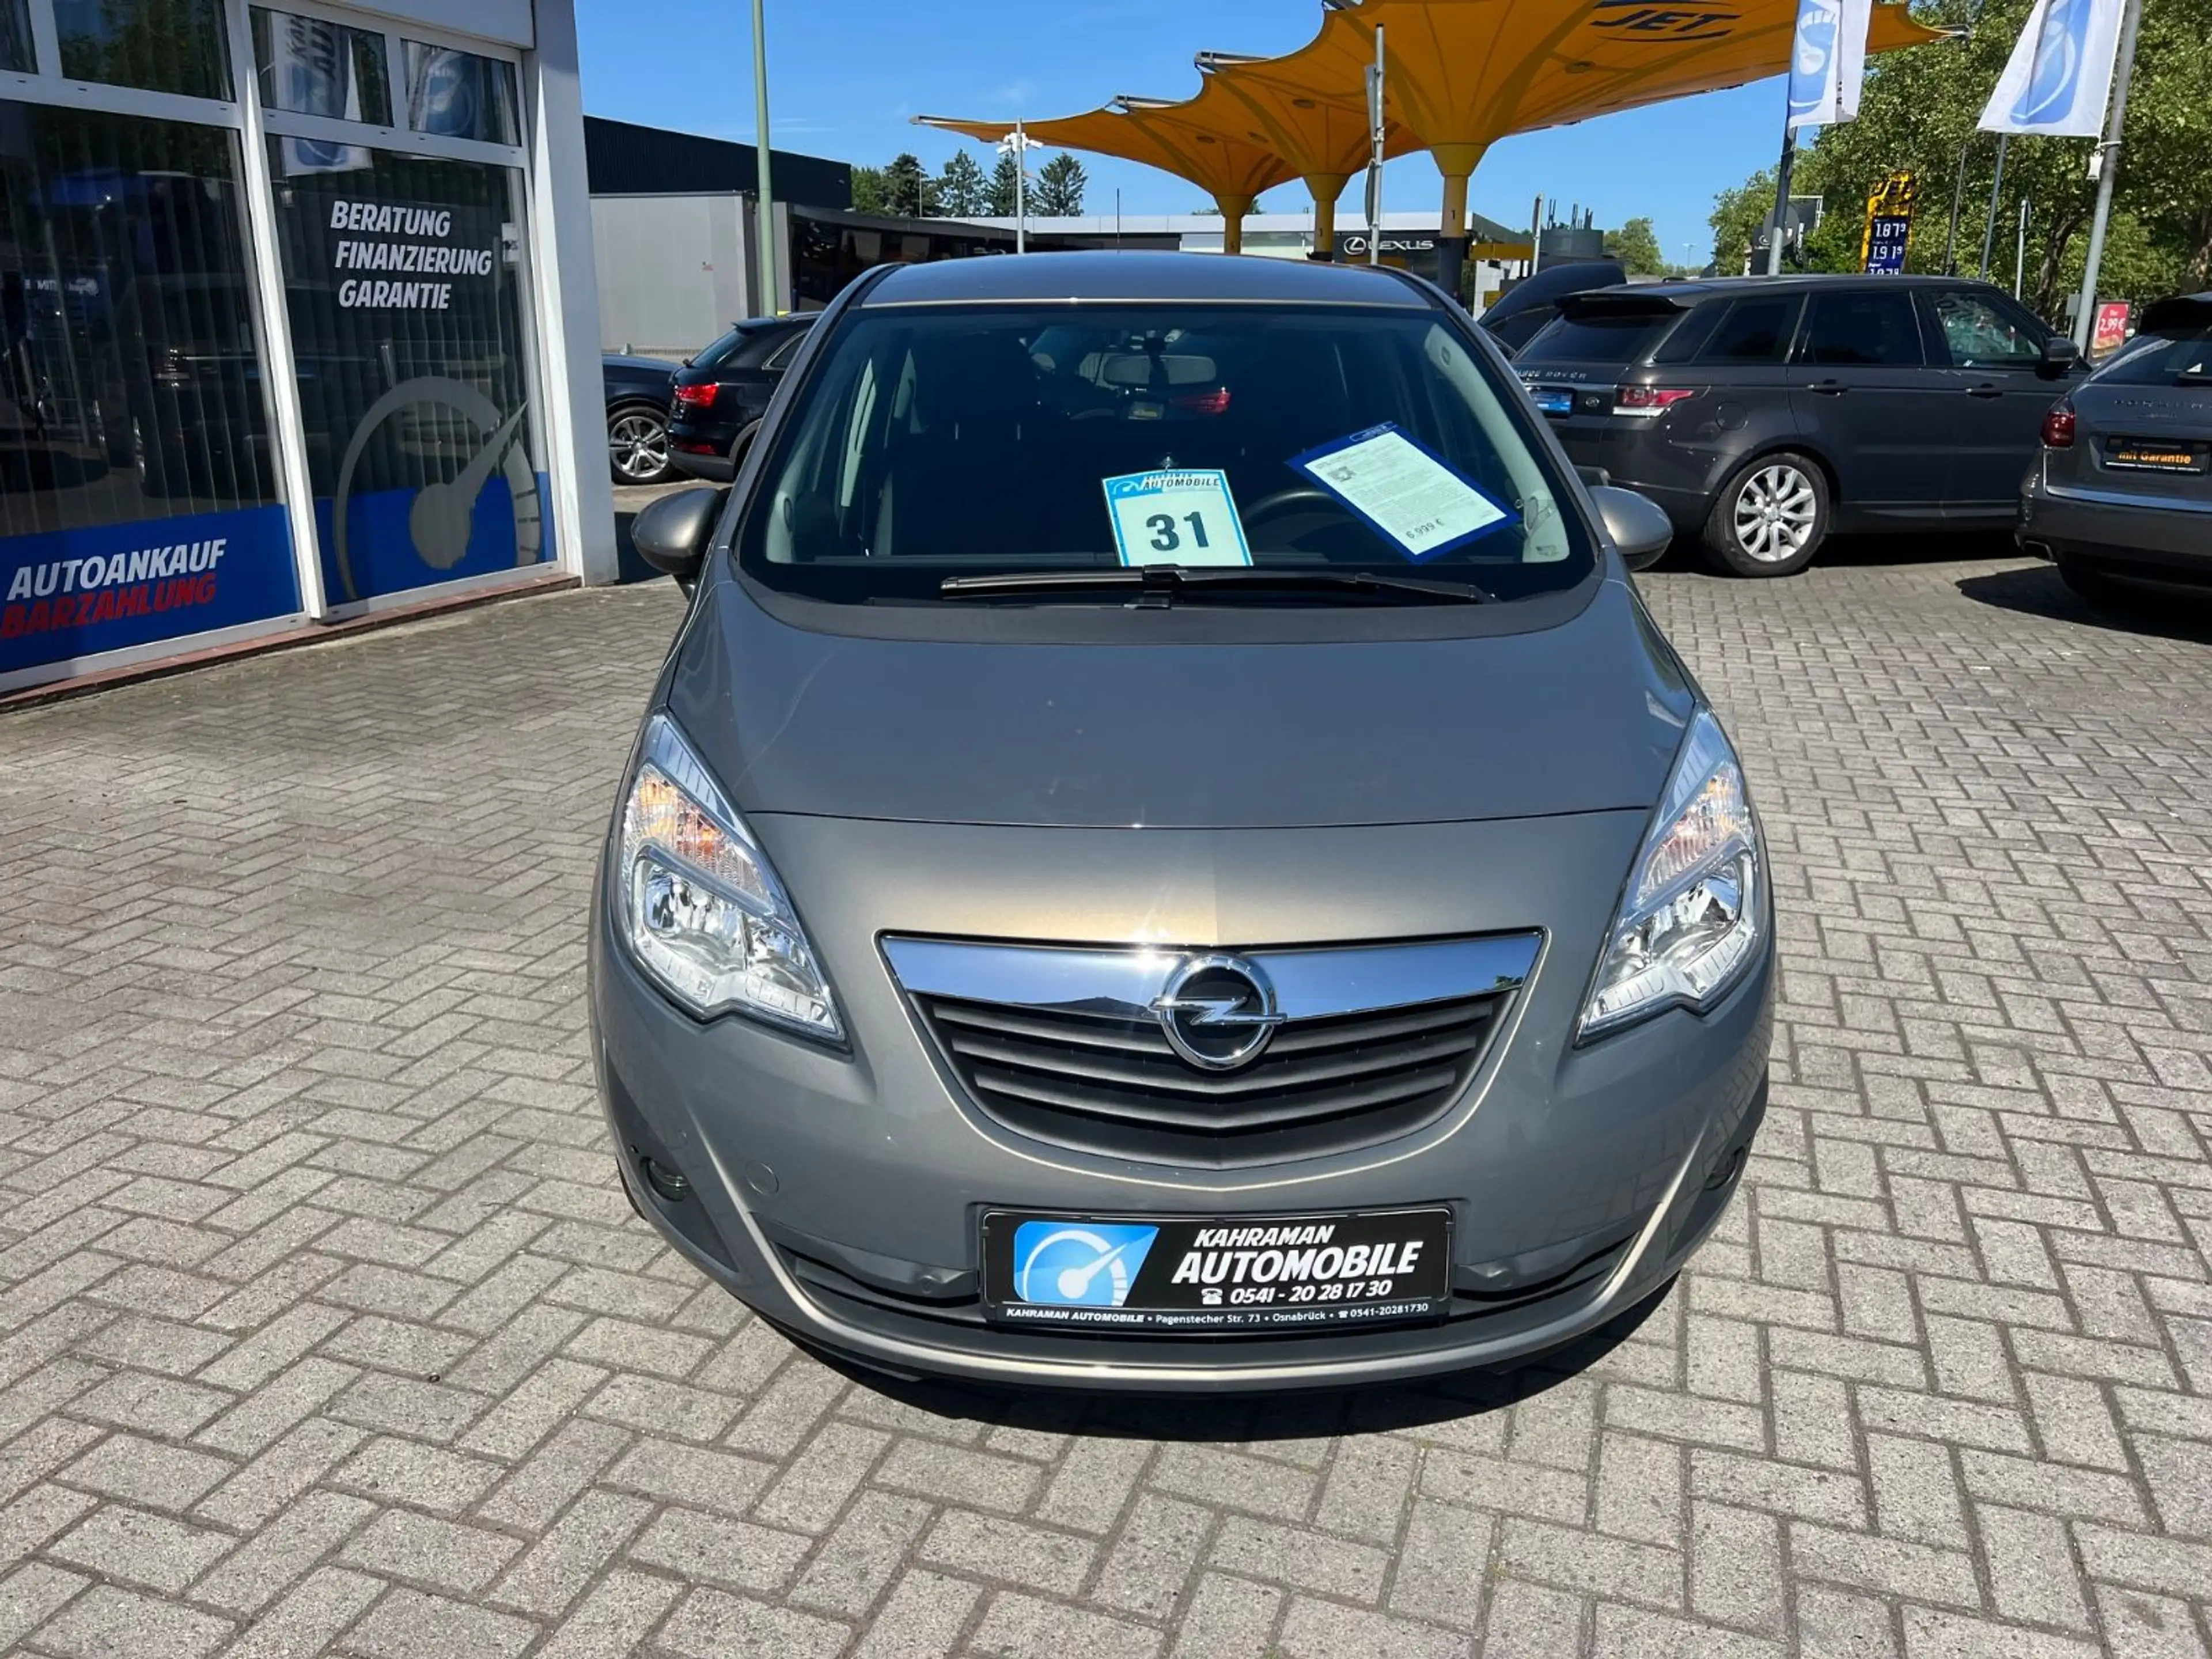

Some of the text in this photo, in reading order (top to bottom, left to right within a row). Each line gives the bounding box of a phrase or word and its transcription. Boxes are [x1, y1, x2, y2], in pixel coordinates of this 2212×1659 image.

[1589, 9, 1741, 31] JET
[330, 200, 450, 237] BERATUNG
[335, 241, 491, 275] FINANZIERUNG
[338, 279, 451, 309] GARANTIE
[2140, 451, 2192, 464] Garantie
[1143, 478, 1219, 488] AUTOMOBILE
[1146, 512, 1209, 551] 31
[7, 539, 226, 601] AUTOANKAUF
[0, 573, 217, 639] BARZAHLUNG
[1194, 1225, 1336, 1248] KAHRAMAN
[1171, 1241, 1423, 1284] AUTOMOBILE
[1230, 1287, 1275, 1304] 0541
[1289, 1285, 1316, 1302] 20
[1317, 1283, 1343, 1300] 28
[1346, 1282, 1365, 1298] 17
[1365, 1279, 1392, 1297] 30
[1006, 1303, 1429, 1326] KAHRAMAN AUTOMOBILE Pagenstecher Str. 73 Osnabrück 0541-20281730
